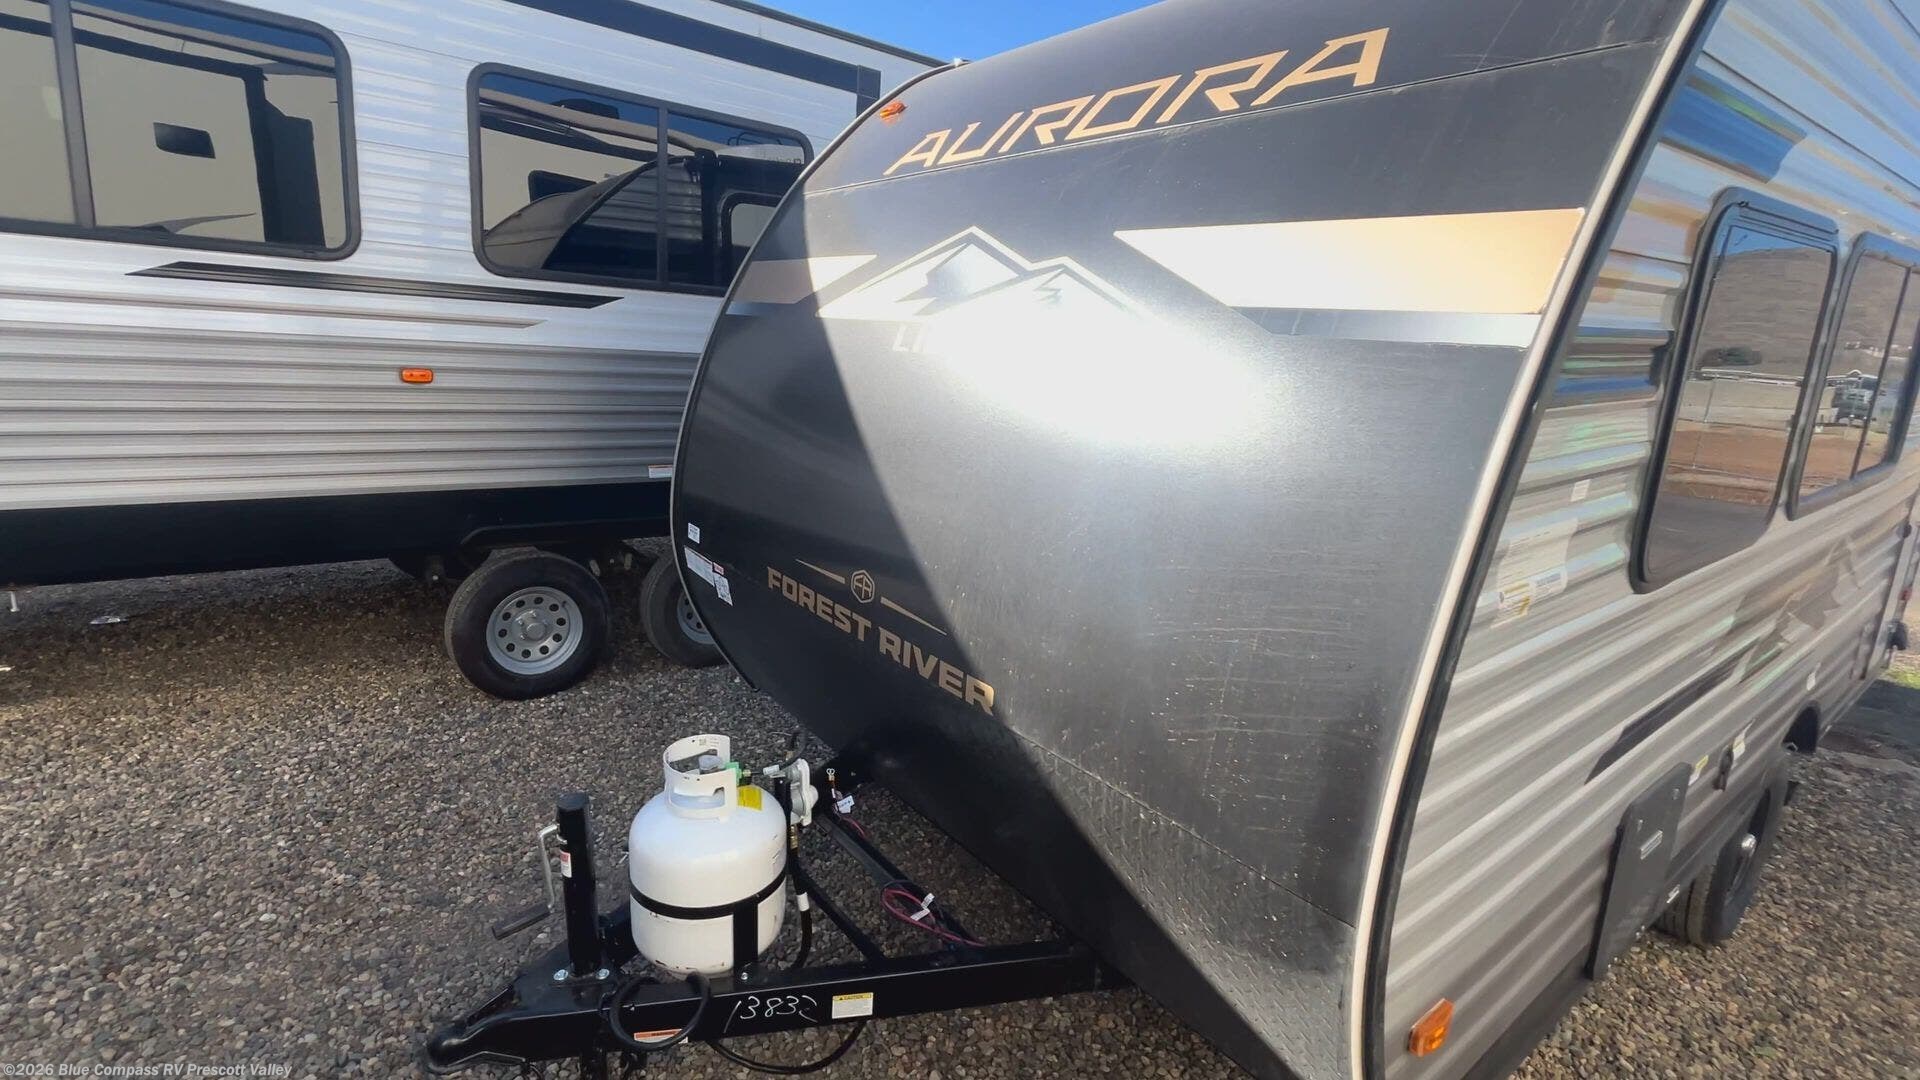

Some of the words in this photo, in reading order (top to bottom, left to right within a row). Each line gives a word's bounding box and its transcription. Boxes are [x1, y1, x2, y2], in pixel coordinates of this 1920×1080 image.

[883, 27, 1390, 176] AURORA
[767, 566, 872, 642] FOREST
[878, 626, 995, 716] RIVER
